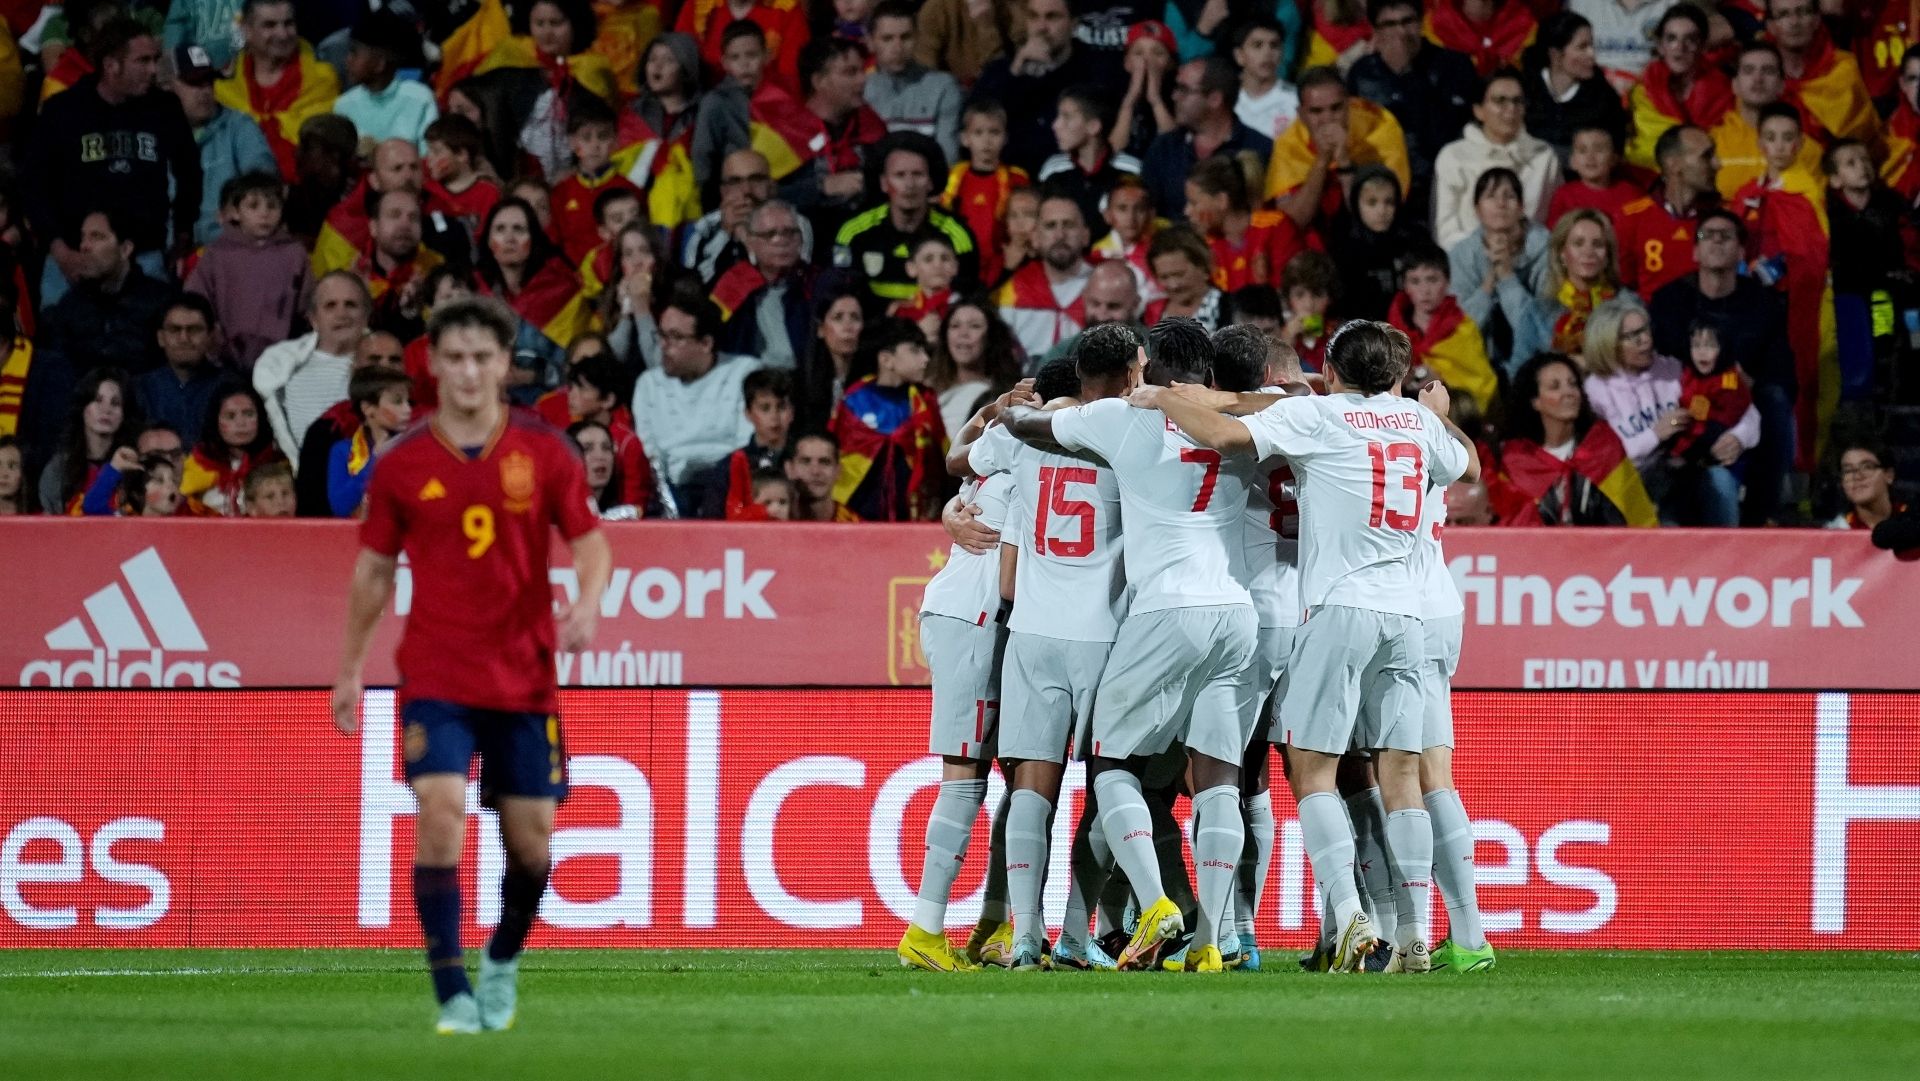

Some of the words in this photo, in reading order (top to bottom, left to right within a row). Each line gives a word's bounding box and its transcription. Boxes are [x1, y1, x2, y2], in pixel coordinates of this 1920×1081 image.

[1644, 239, 1663, 272] 8
[1180, 448, 1222, 512] 7
[1367, 441, 1423, 531] 13
[462, 505, 495, 559] 9
[1035, 466, 1098, 558] 15
[19, 646, 241, 687] adidas
[1202, 858, 1235, 871] suisse
